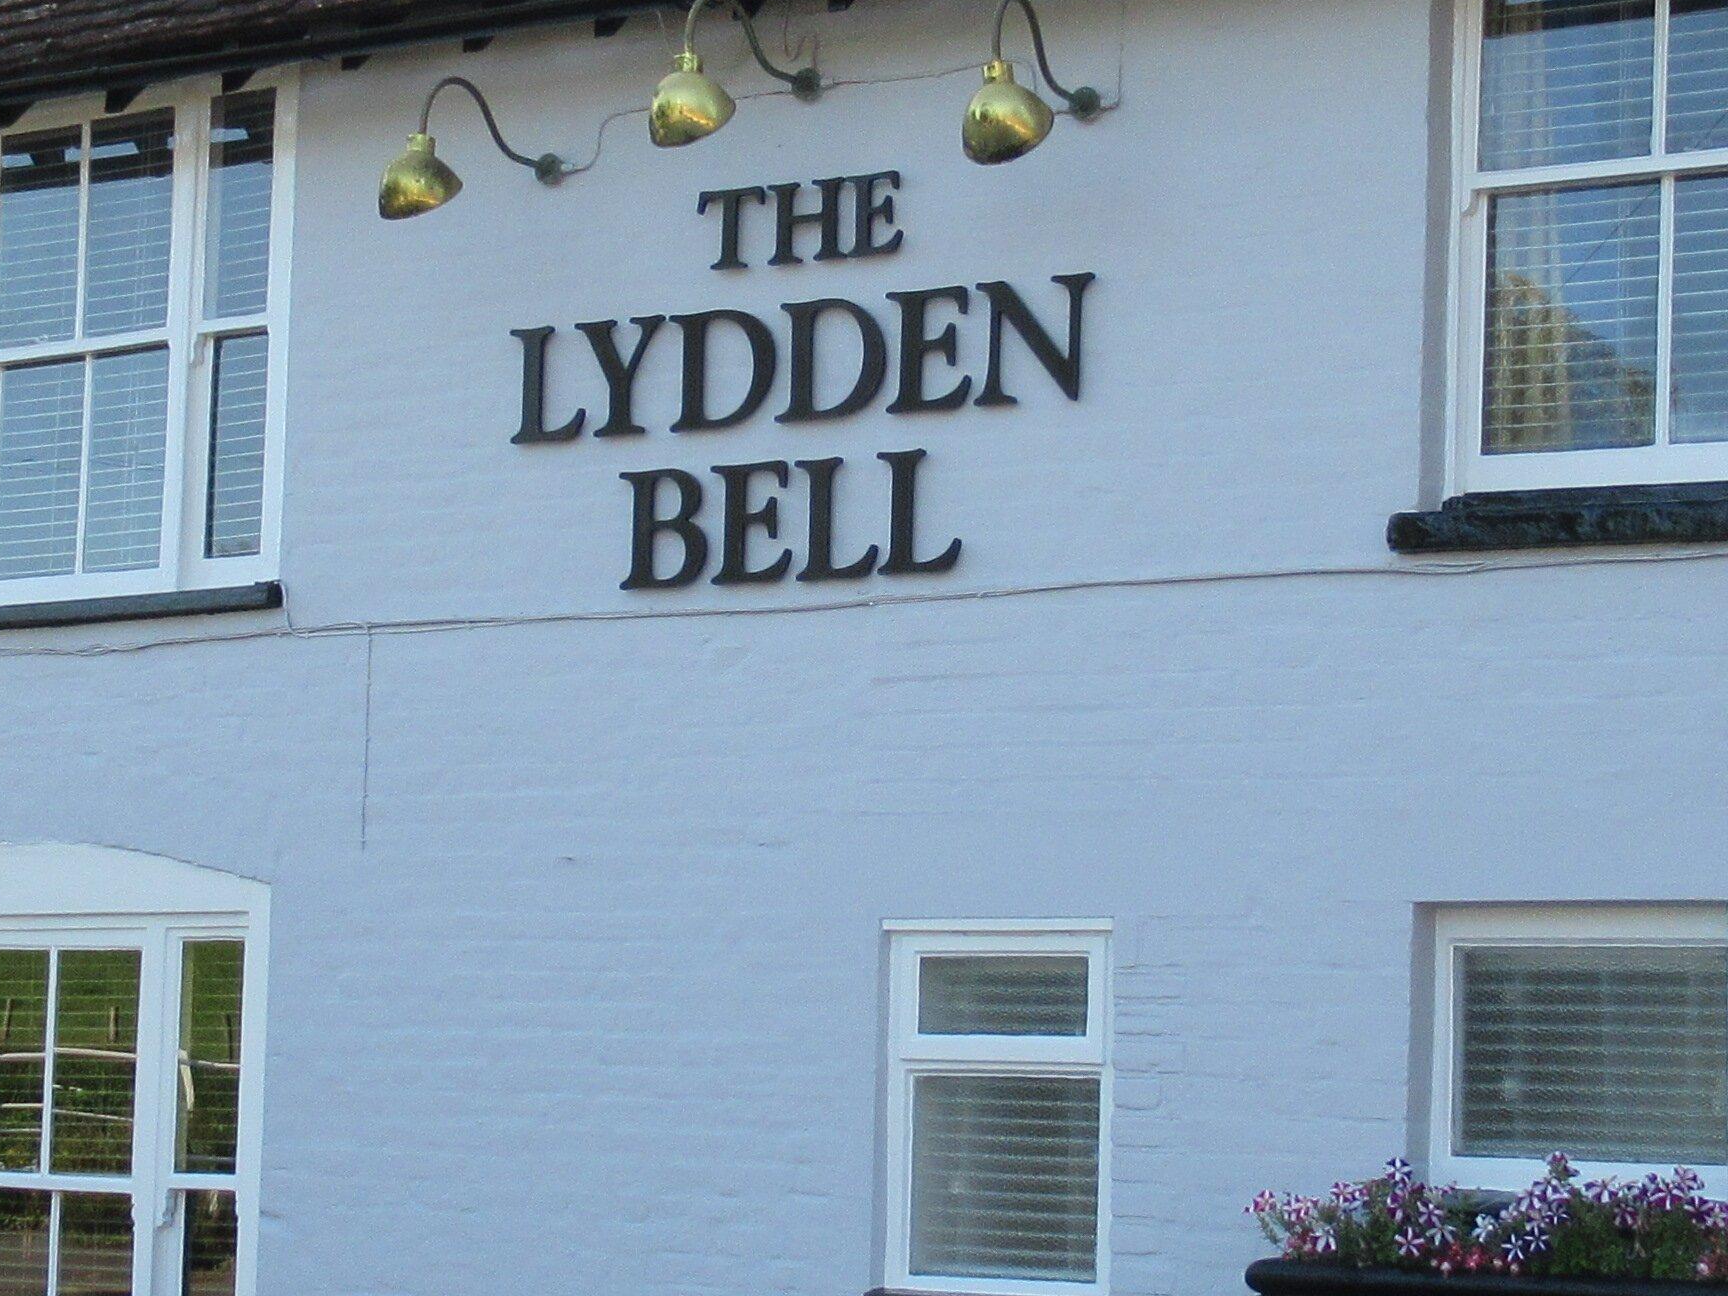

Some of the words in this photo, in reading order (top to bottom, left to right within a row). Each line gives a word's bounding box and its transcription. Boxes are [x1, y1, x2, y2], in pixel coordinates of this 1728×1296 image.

[696, 169, 904, 271] THE
[509, 271, 1097, 445] LYDDEN
[618, 447, 963, 591] BELL
